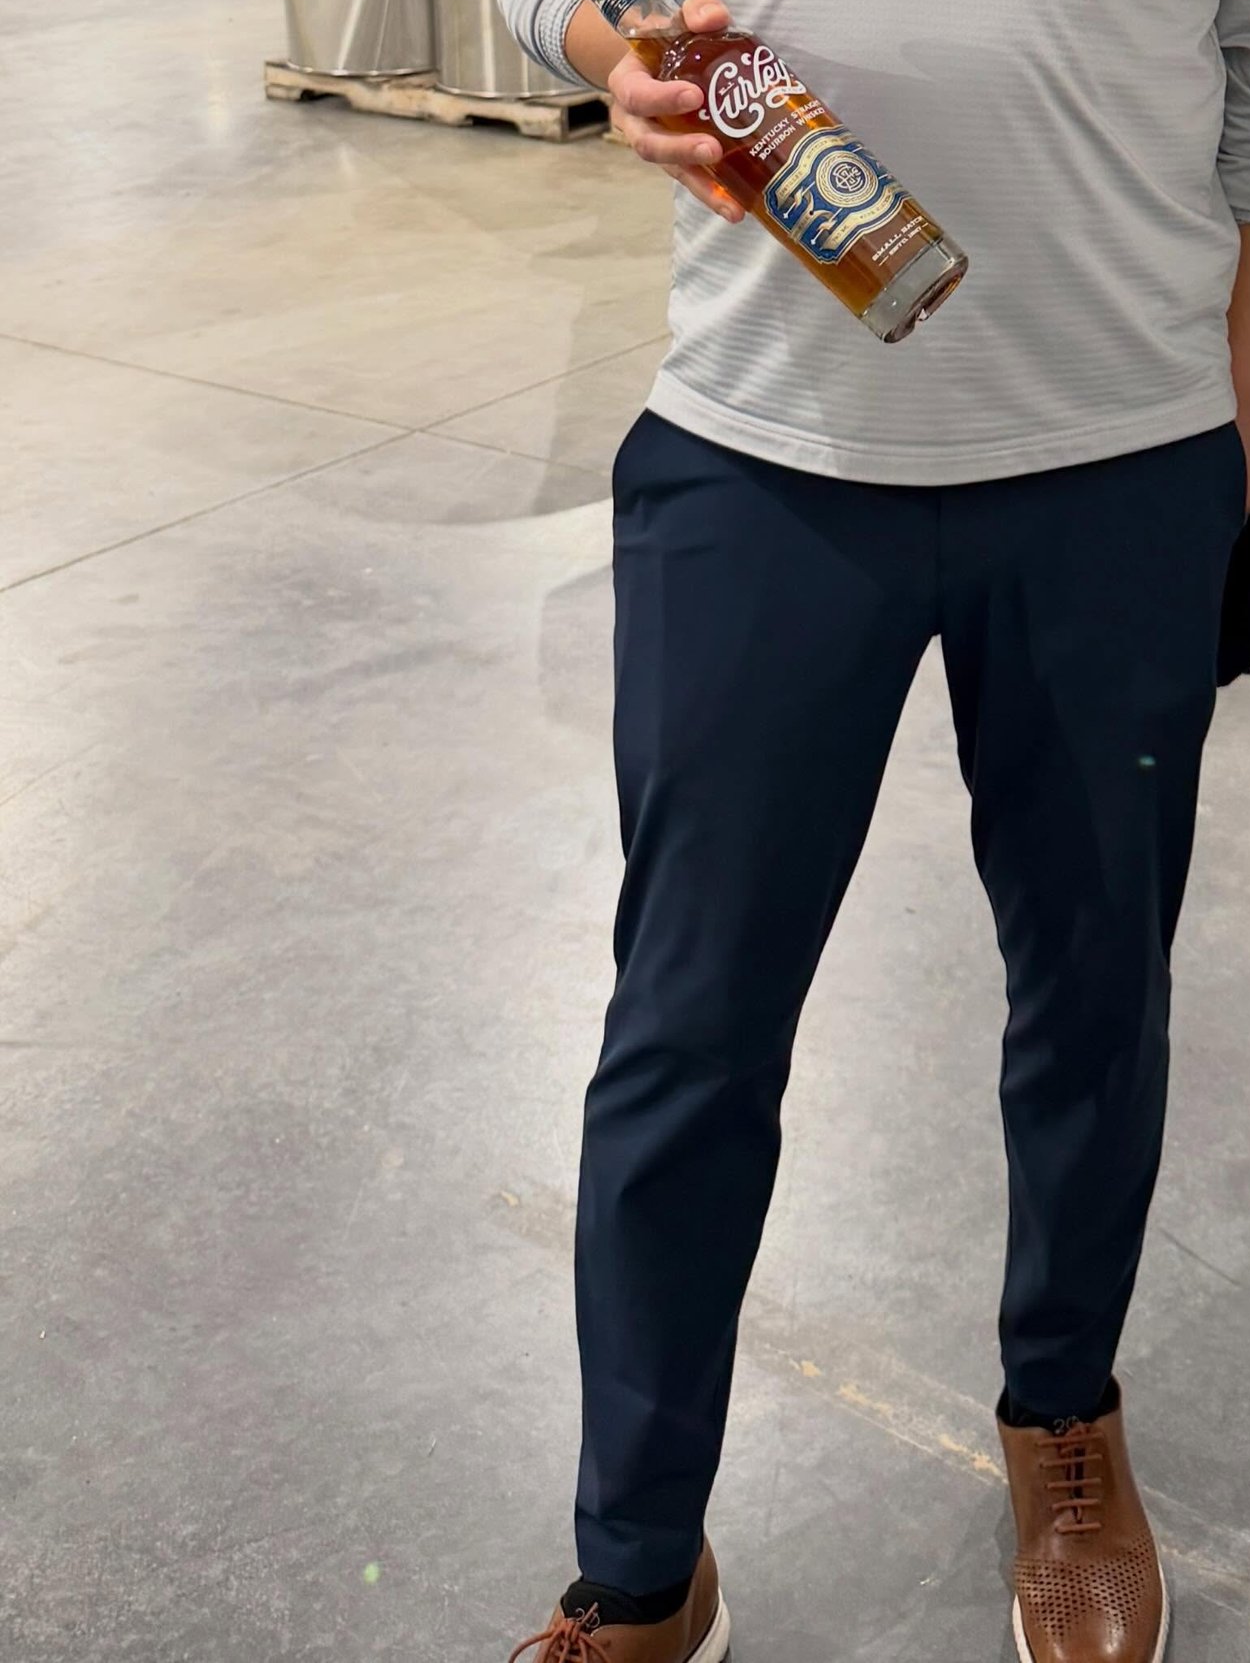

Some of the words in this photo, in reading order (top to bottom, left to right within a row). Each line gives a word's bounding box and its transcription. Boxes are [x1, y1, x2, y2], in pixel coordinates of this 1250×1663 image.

[698, 45, 806, 138] Curley
[749, 118, 790, 157] KENTUCKY
[758, 125, 797, 161] BOURBON
